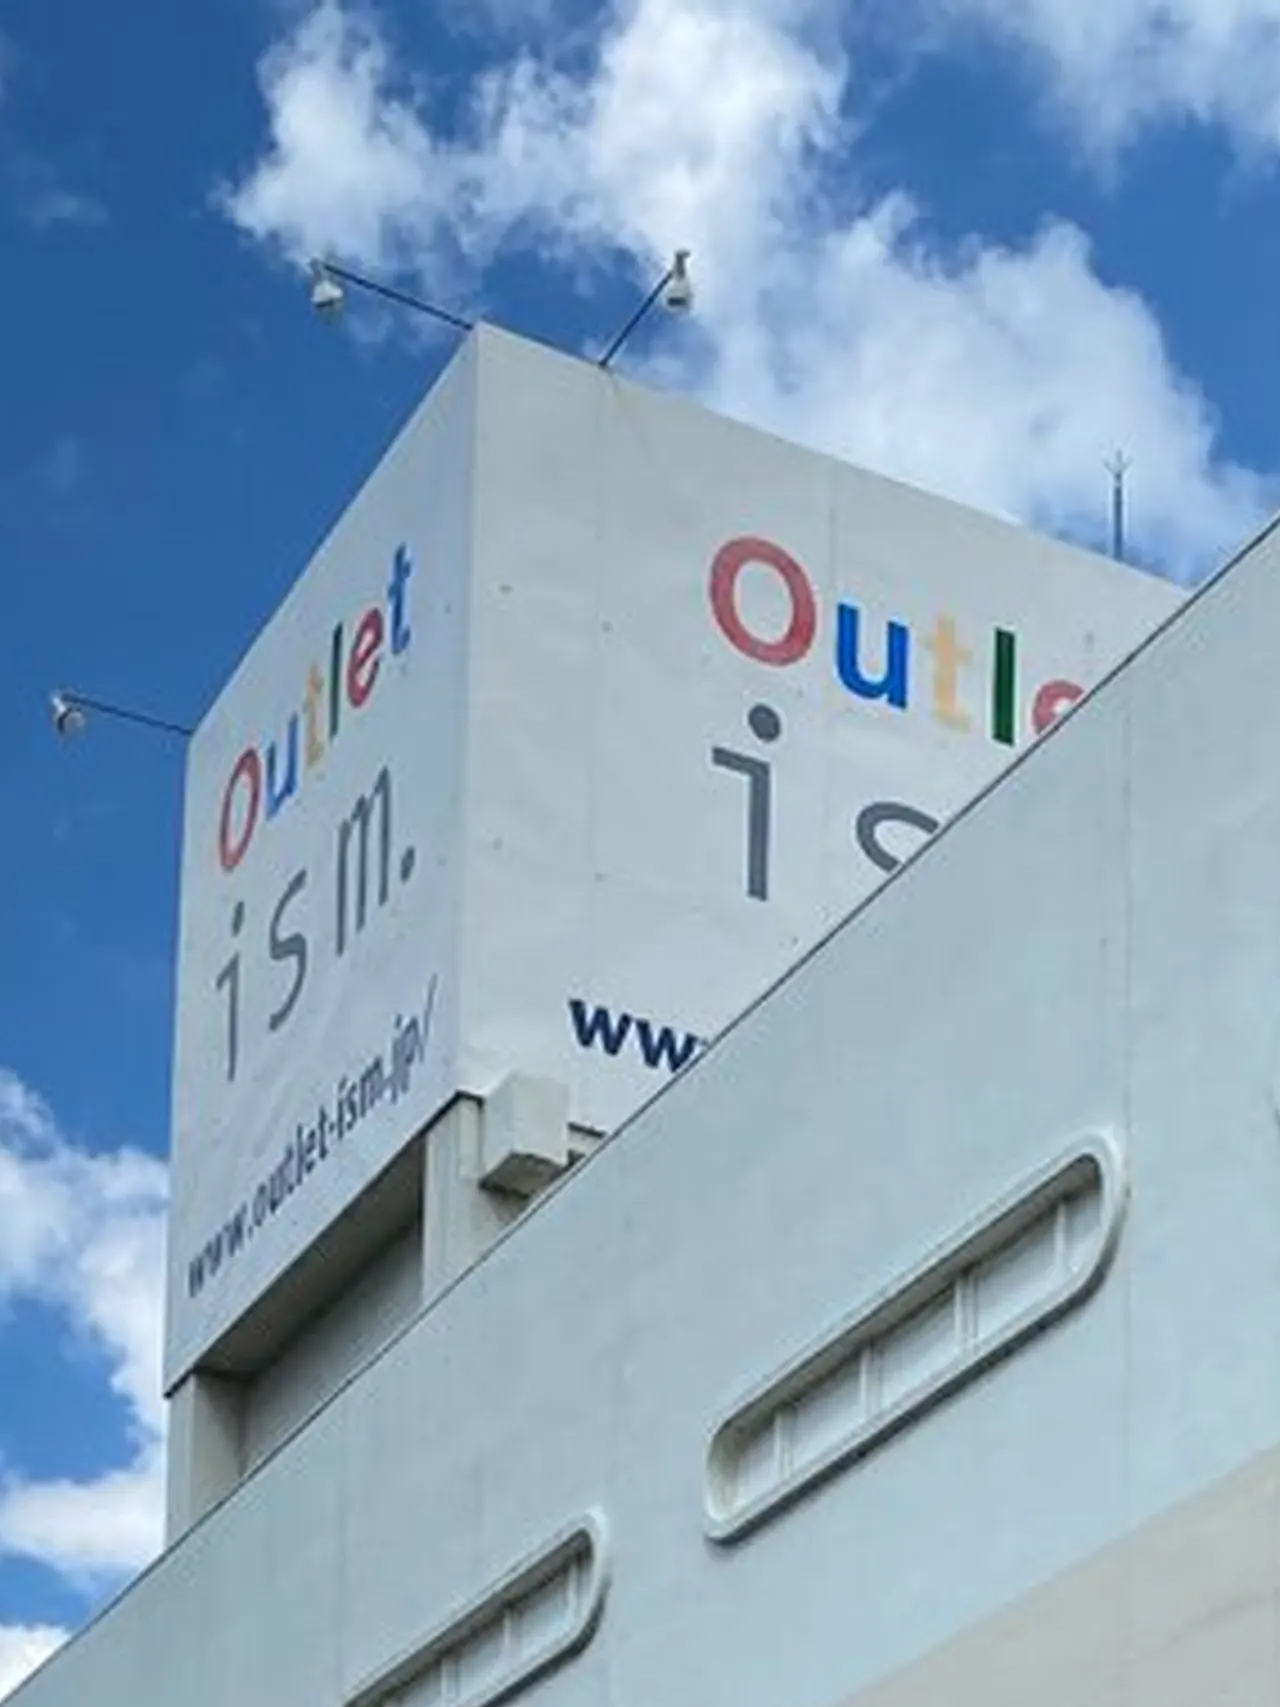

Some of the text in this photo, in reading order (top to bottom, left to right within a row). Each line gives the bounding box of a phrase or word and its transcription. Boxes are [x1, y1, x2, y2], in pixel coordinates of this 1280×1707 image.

[219, 540, 416, 873] Outlet
[215, 765, 417, 1083] ism.
[568, 998, 709, 1074] ww
